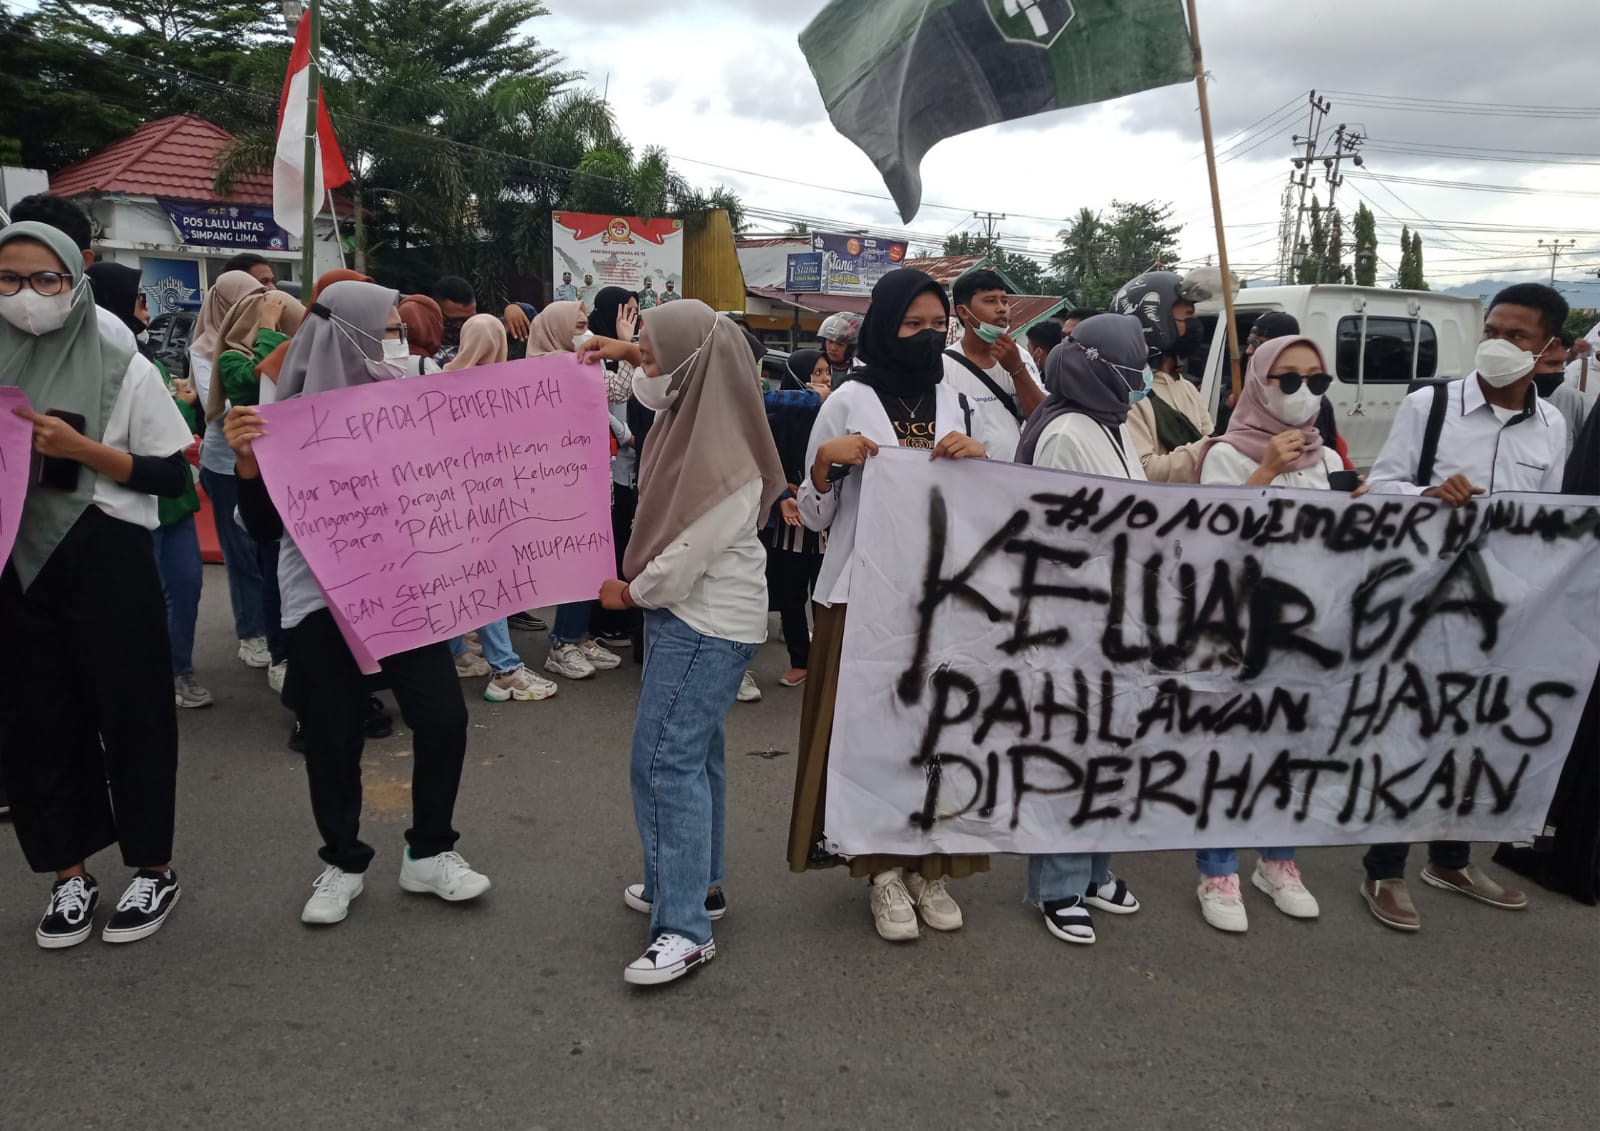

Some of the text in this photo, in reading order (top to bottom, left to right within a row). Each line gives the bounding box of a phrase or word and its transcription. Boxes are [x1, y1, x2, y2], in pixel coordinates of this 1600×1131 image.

[183, 217, 203, 227] POS
[205, 219, 229, 229] LALU
[232, 221, 264, 231] LINTAS
[191, 230, 258, 242] SIMPANG LIMA
[299, 378, 562, 450] KEPADA PEMERINTAH
[287, 485, 320, 520] Agar
[329, 469, 379, 500] Dapat
[561, 429, 591, 448] dan
[398, 486, 455, 514] Derajat
[512, 530, 610, 565] MELUPAKAN
[1156, 497, 1429, 556] NOVEMBER
[363, 565, 537, 642] SEJARAH
[911, 662, 1578, 765] PAHLAWAN HARUS
[909, 744, 1532, 831] DIPERHATIKAN
